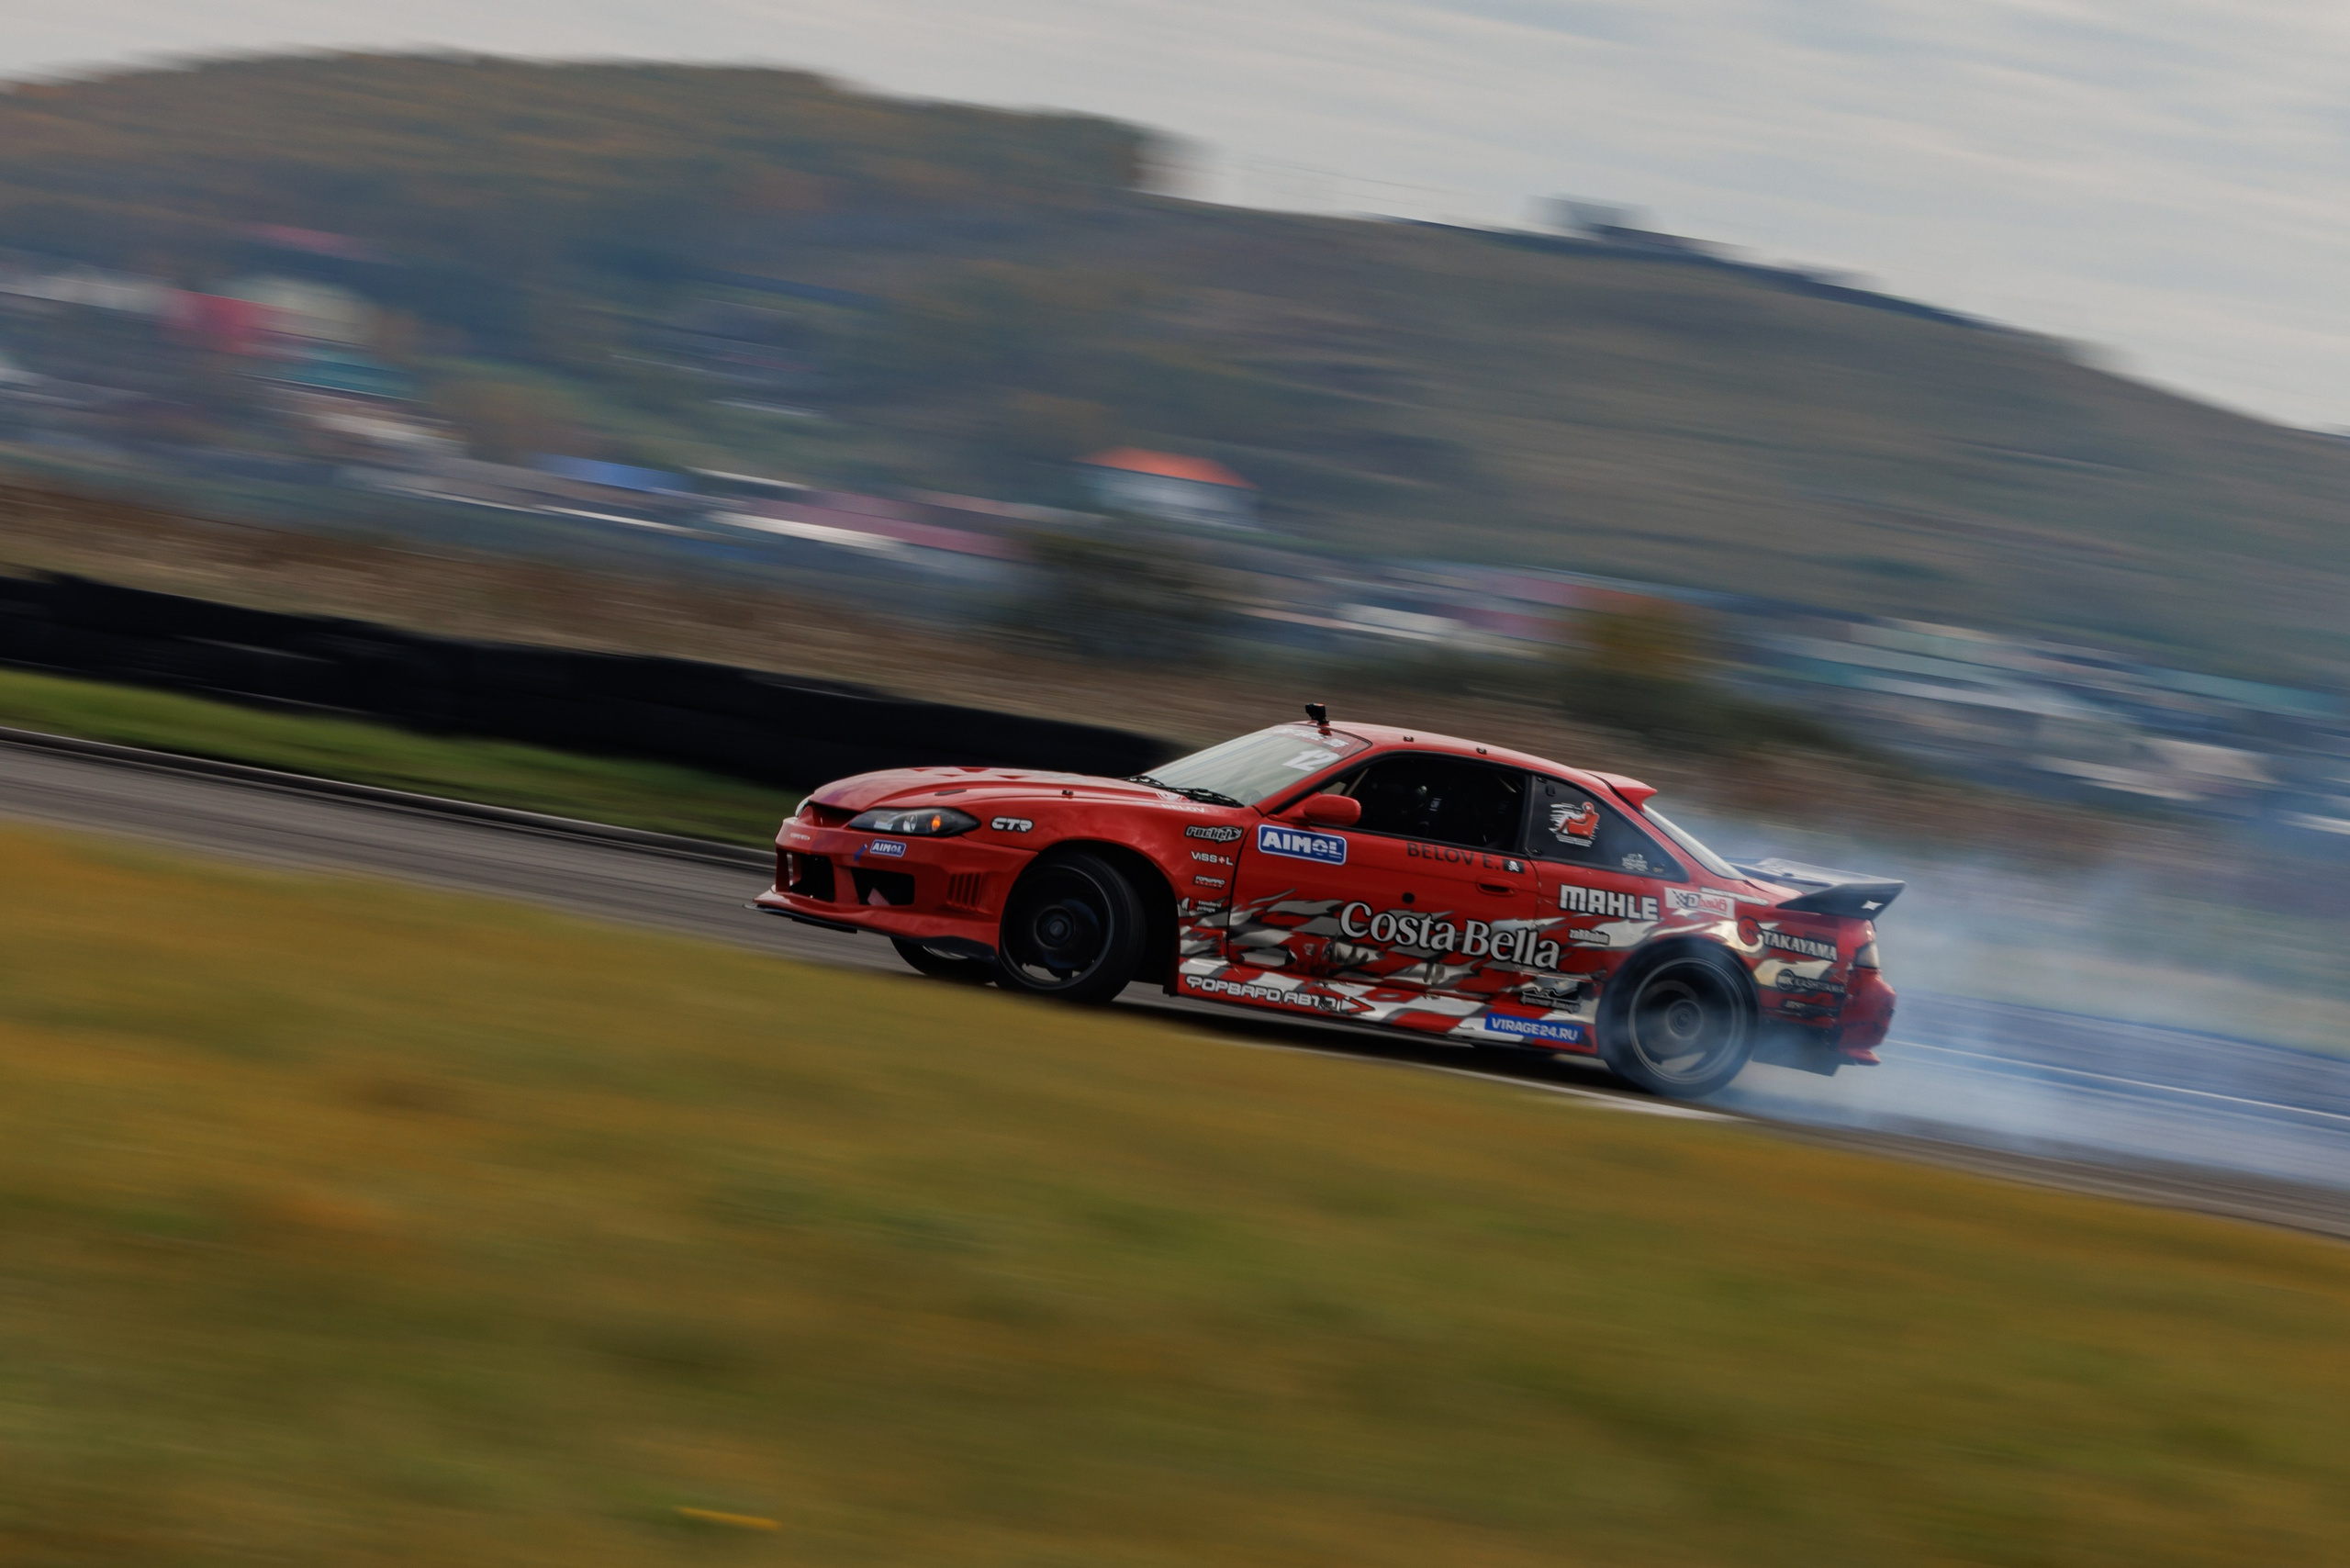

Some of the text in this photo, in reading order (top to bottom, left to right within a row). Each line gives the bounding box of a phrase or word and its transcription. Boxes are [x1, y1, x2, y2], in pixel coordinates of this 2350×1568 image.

[1281, 750, 1341, 771] 12
[991, 817, 1033, 833] CTR
[871, 843, 903, 855] AIMOL
[1261, 831, 1343, 859] AIMOL
[1406, 842, 1501, 870] BELOV E.
[1560, 884, 1659, 921] MAHLE
[1340, 902, 1561, 969] Costa Bella
[1762, 930, 1838, 962] TAKAYAMA
[1186, 976, 1281, 1002] ФОРВАРД
[1492, 1017, 1579, 1041] VIRAGE24.RU
